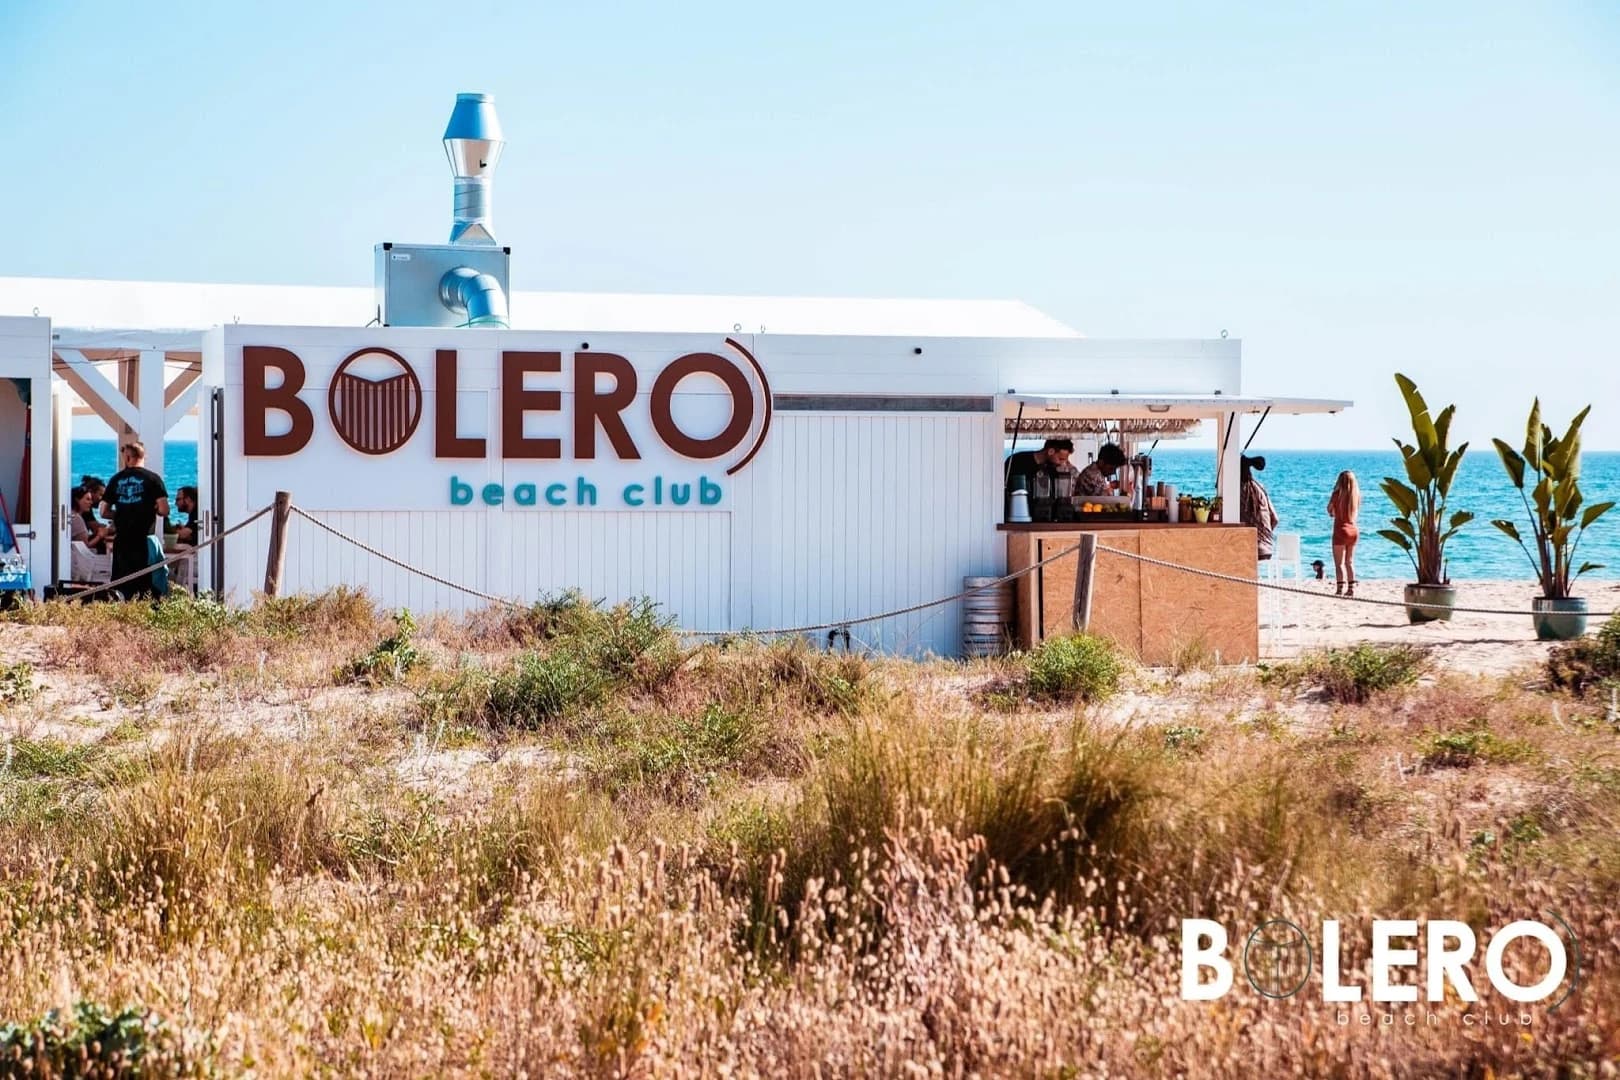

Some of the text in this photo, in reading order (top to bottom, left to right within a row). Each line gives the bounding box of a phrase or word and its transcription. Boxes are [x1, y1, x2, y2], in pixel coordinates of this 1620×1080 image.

[242, 344, 755, 461] BOLERO
[450, 476, 722, 506] beach club
